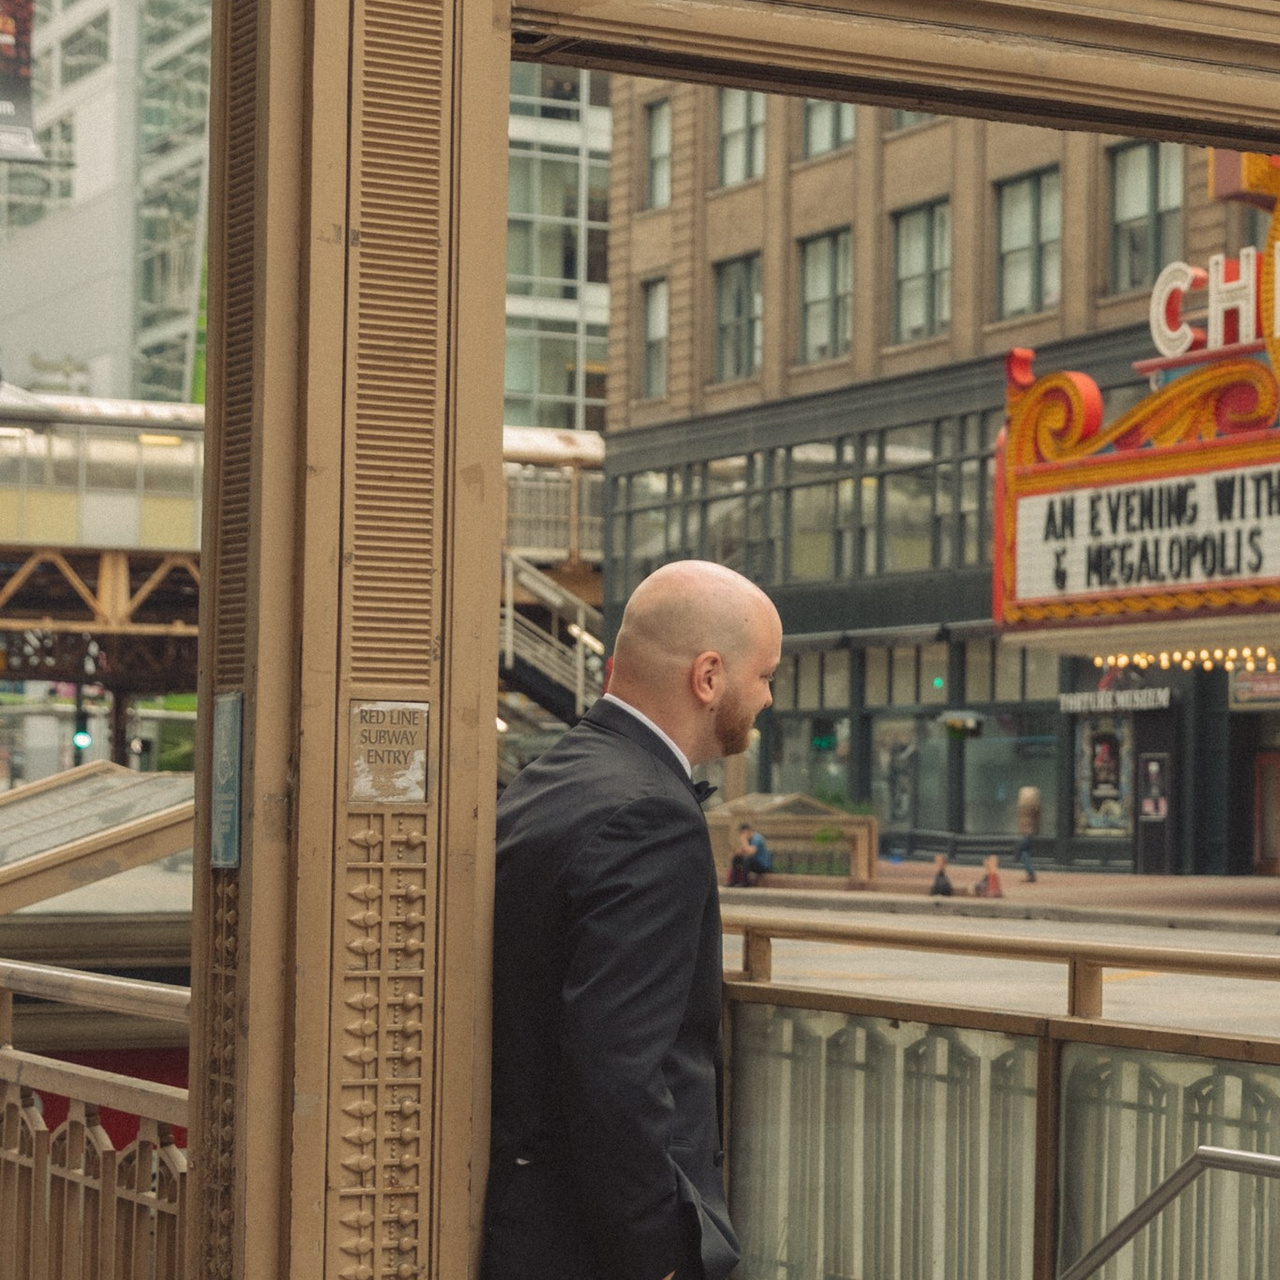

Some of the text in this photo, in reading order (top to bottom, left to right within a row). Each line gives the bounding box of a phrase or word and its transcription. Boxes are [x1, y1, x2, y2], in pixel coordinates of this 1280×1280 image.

[1043, 495, 1076, 542] AN
[1089, 479, 1199, 538] EVENING
[1086, 527, 1264, 588] MEGALOPOLIS
[359, 709, 420, 726] RED LINE
[359, 729, 418, 746] SUBWAY
[366, 749, 411, 765] ENTRY
